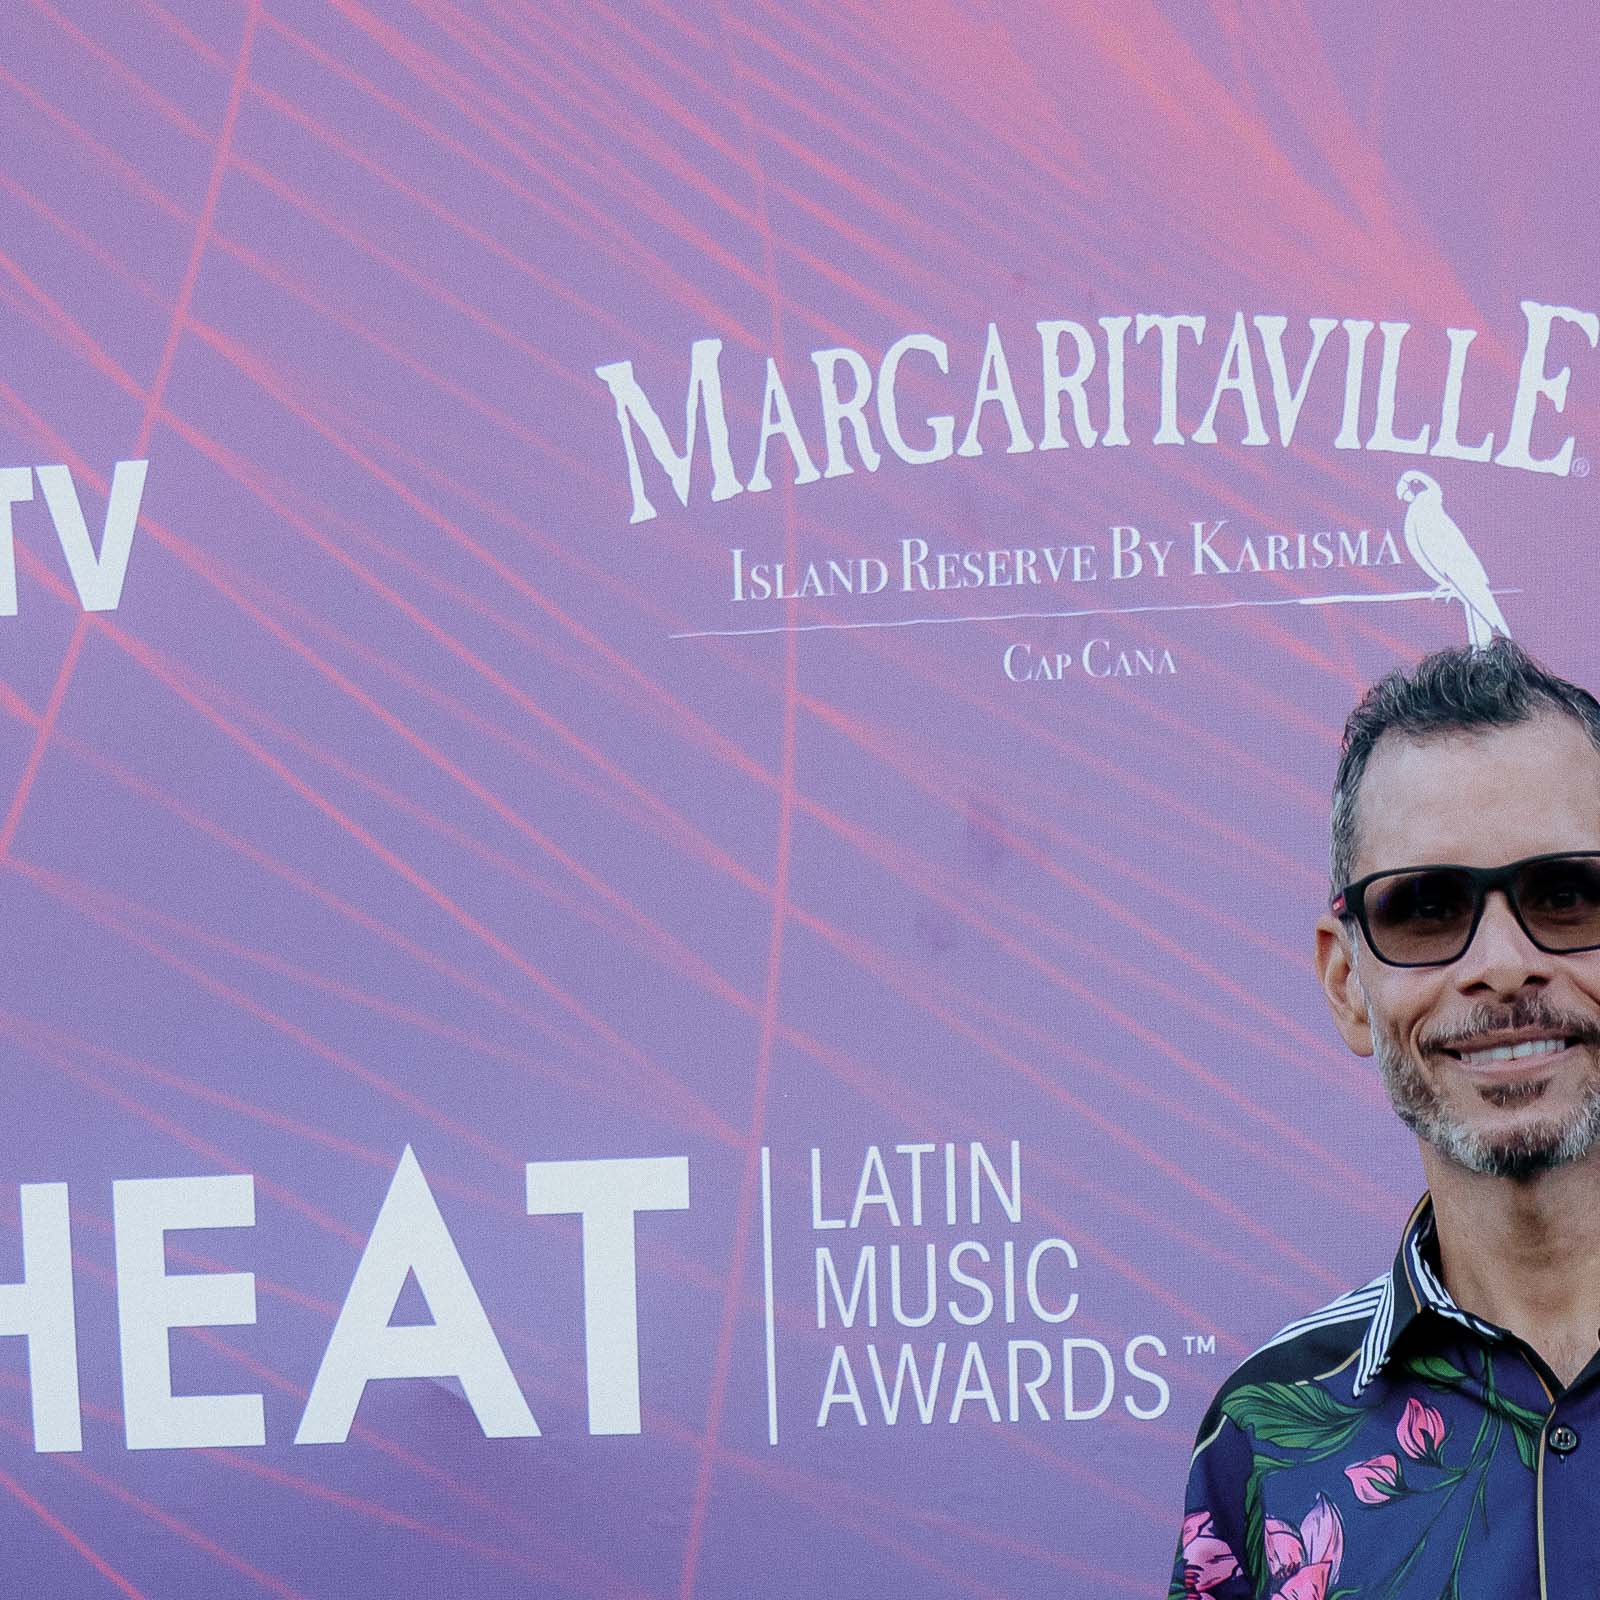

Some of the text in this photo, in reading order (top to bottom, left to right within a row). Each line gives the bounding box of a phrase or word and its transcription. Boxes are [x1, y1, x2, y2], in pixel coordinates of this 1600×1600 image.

[732, 520, 1402, 601] ISLAND RESERVE BY KARISMA
[1003, 639, 1176, 682] CAP CANA
[811, 1140, 1021, 1230] LATIN
[815, 1238, 1079, 1329] MUSIC
